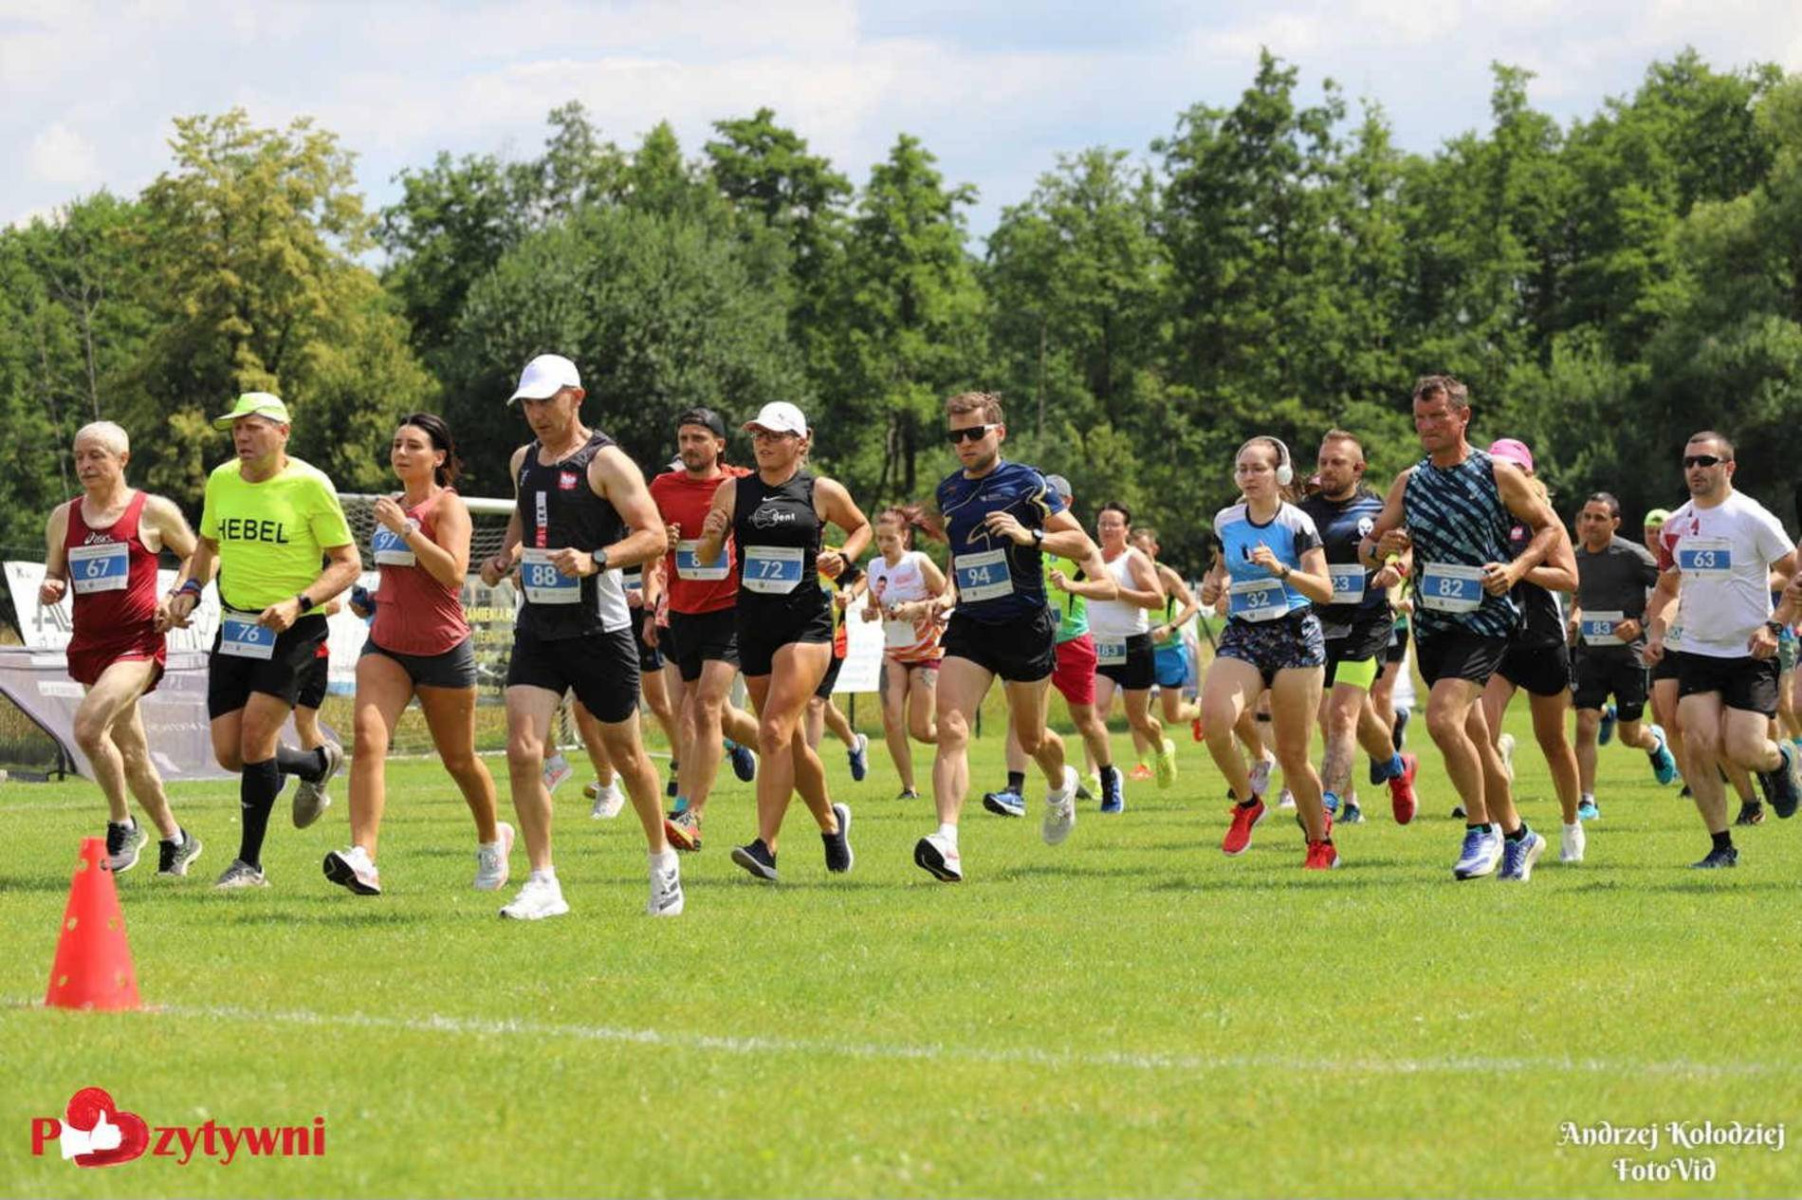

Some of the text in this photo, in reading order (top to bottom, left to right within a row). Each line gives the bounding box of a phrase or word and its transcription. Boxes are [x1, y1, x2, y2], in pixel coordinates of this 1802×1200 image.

[86, 558, 110, 578] 67
[1693, 551, 1715, 567] 63
[532, 564, 557, 586] 88
[760, 560, 783, 578] 72
[968, 566, 991, 586] 94
[1440, 579, 1463, 597] 82
[1247, 591, 1270, 608] 32
[237, 624, 260, 642] 76
[1592, 622, 1611, 636] 83
